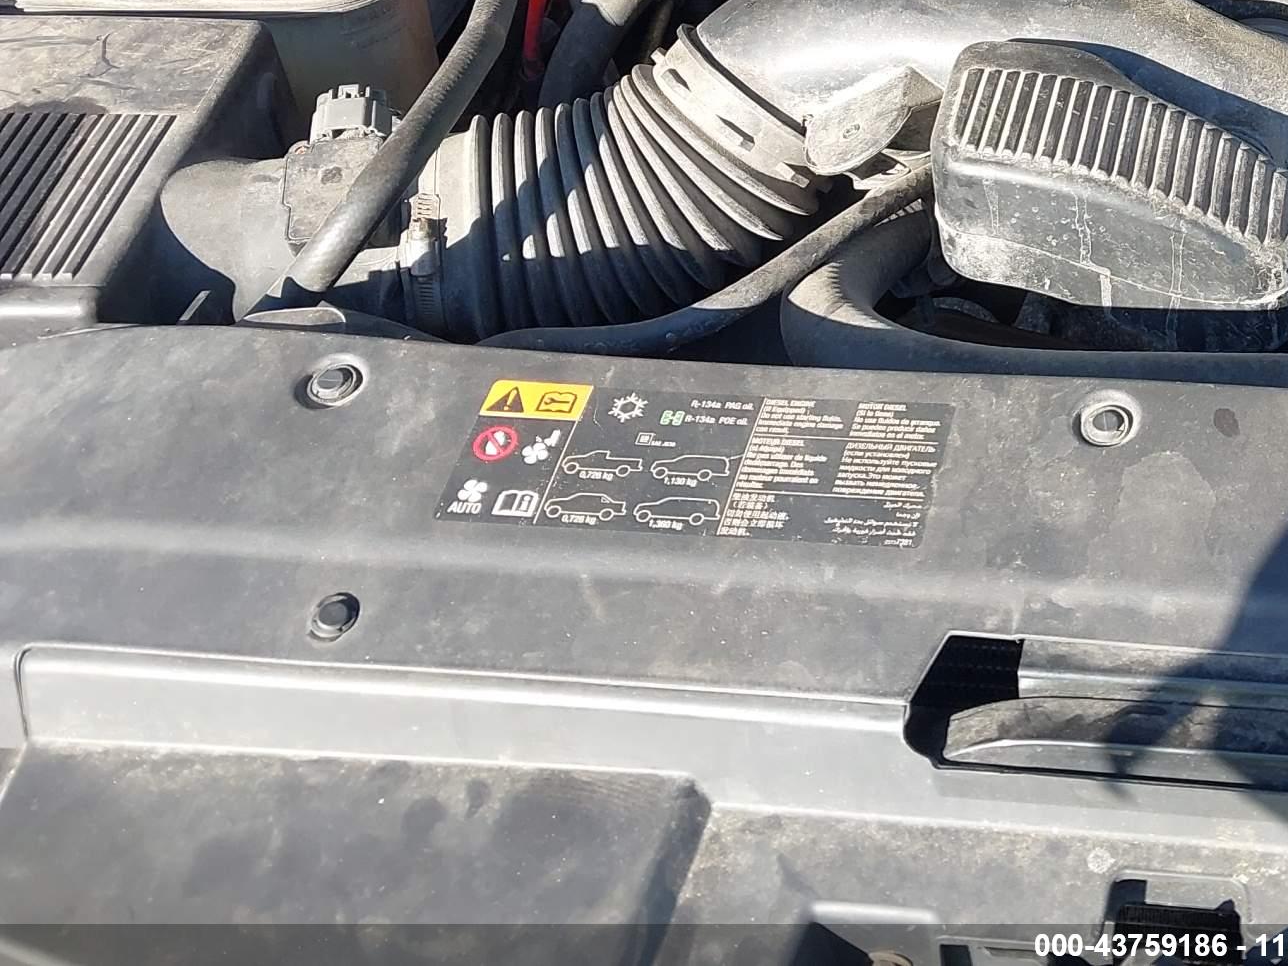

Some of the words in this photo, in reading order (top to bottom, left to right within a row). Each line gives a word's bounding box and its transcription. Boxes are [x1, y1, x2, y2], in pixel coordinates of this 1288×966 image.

[602, 472, 613, 481] kg
[686, 478, 697, 487] kg
[447, 502, 482, 514] AUTO
[585, 516, 597, 525] kg
[672, 521, 683, 530] kg
